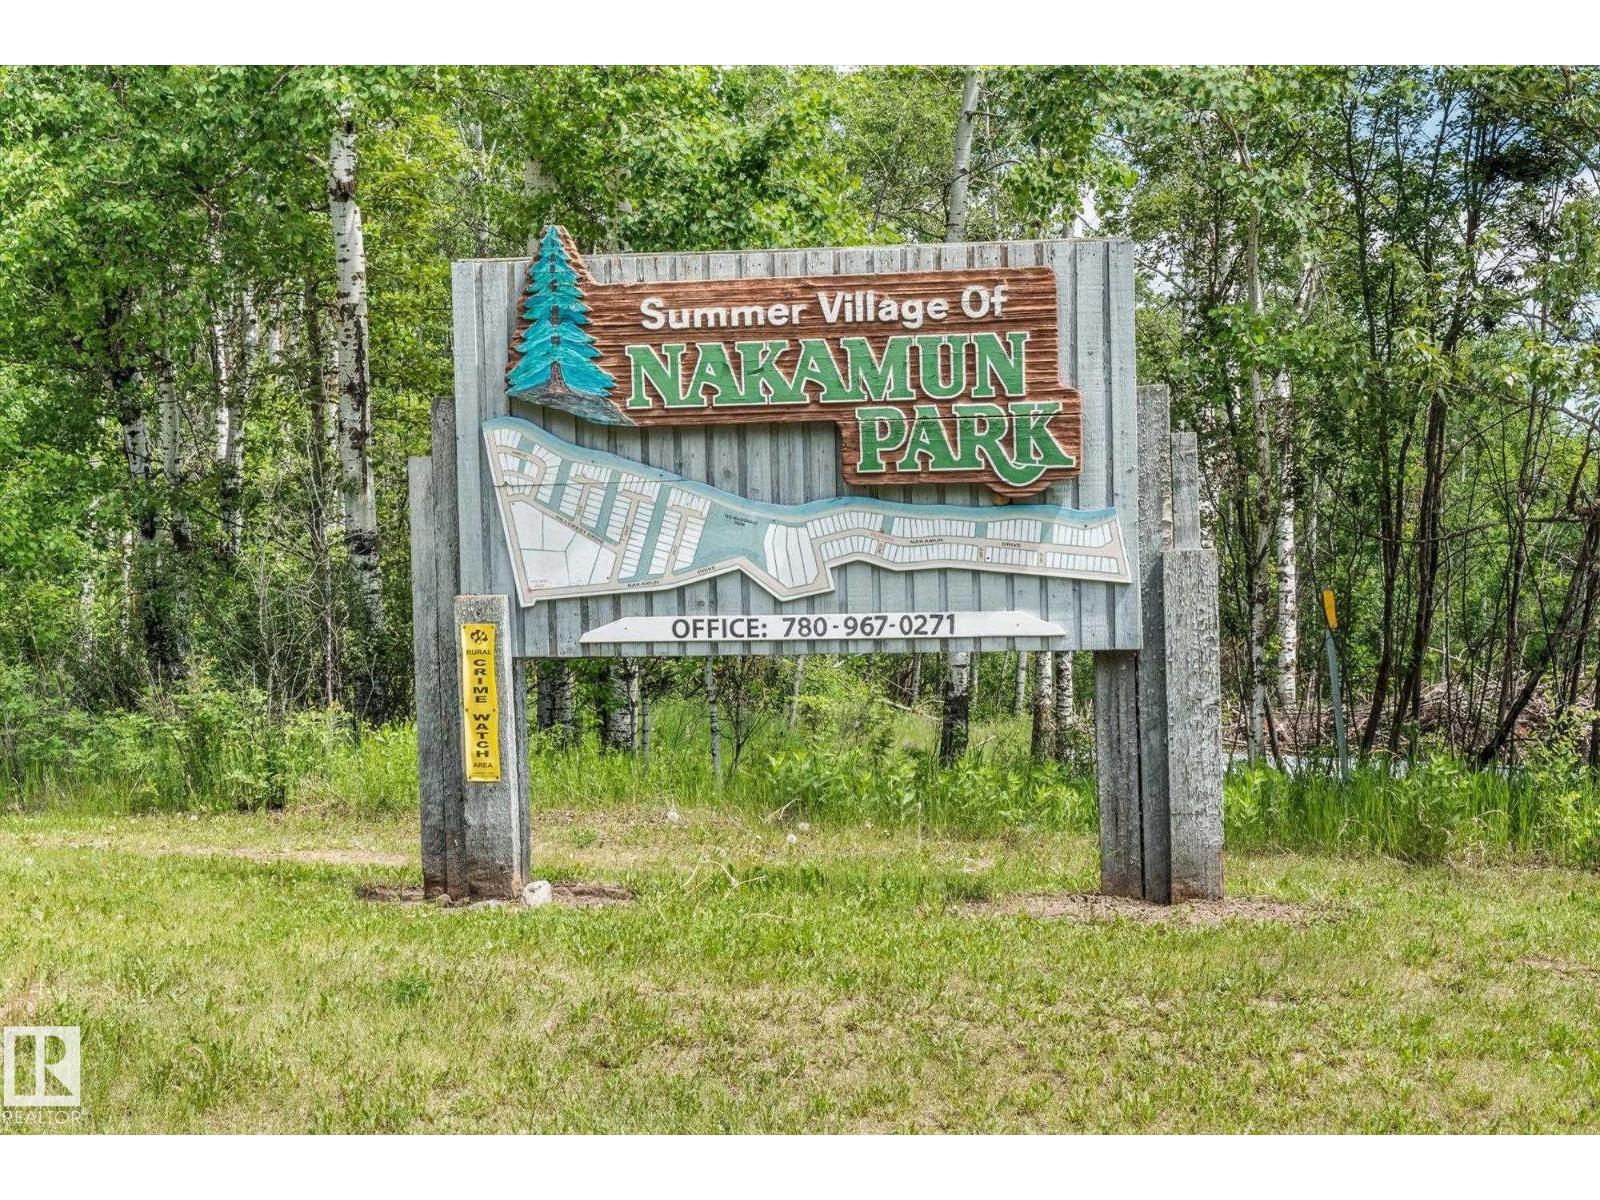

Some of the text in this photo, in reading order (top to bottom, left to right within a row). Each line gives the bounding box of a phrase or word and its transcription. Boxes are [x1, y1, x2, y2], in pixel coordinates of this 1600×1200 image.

[640, 284, 1008, 331] Summer Village Of
[624, 331, 1030, 410] NAKAMUN
[854, 401, 1076, 487] PARK
[671, 618, 768, 640] OFFICE:
[473, 659, 489, 704] CRIME
[473, 713, 491, 758] WATCH
